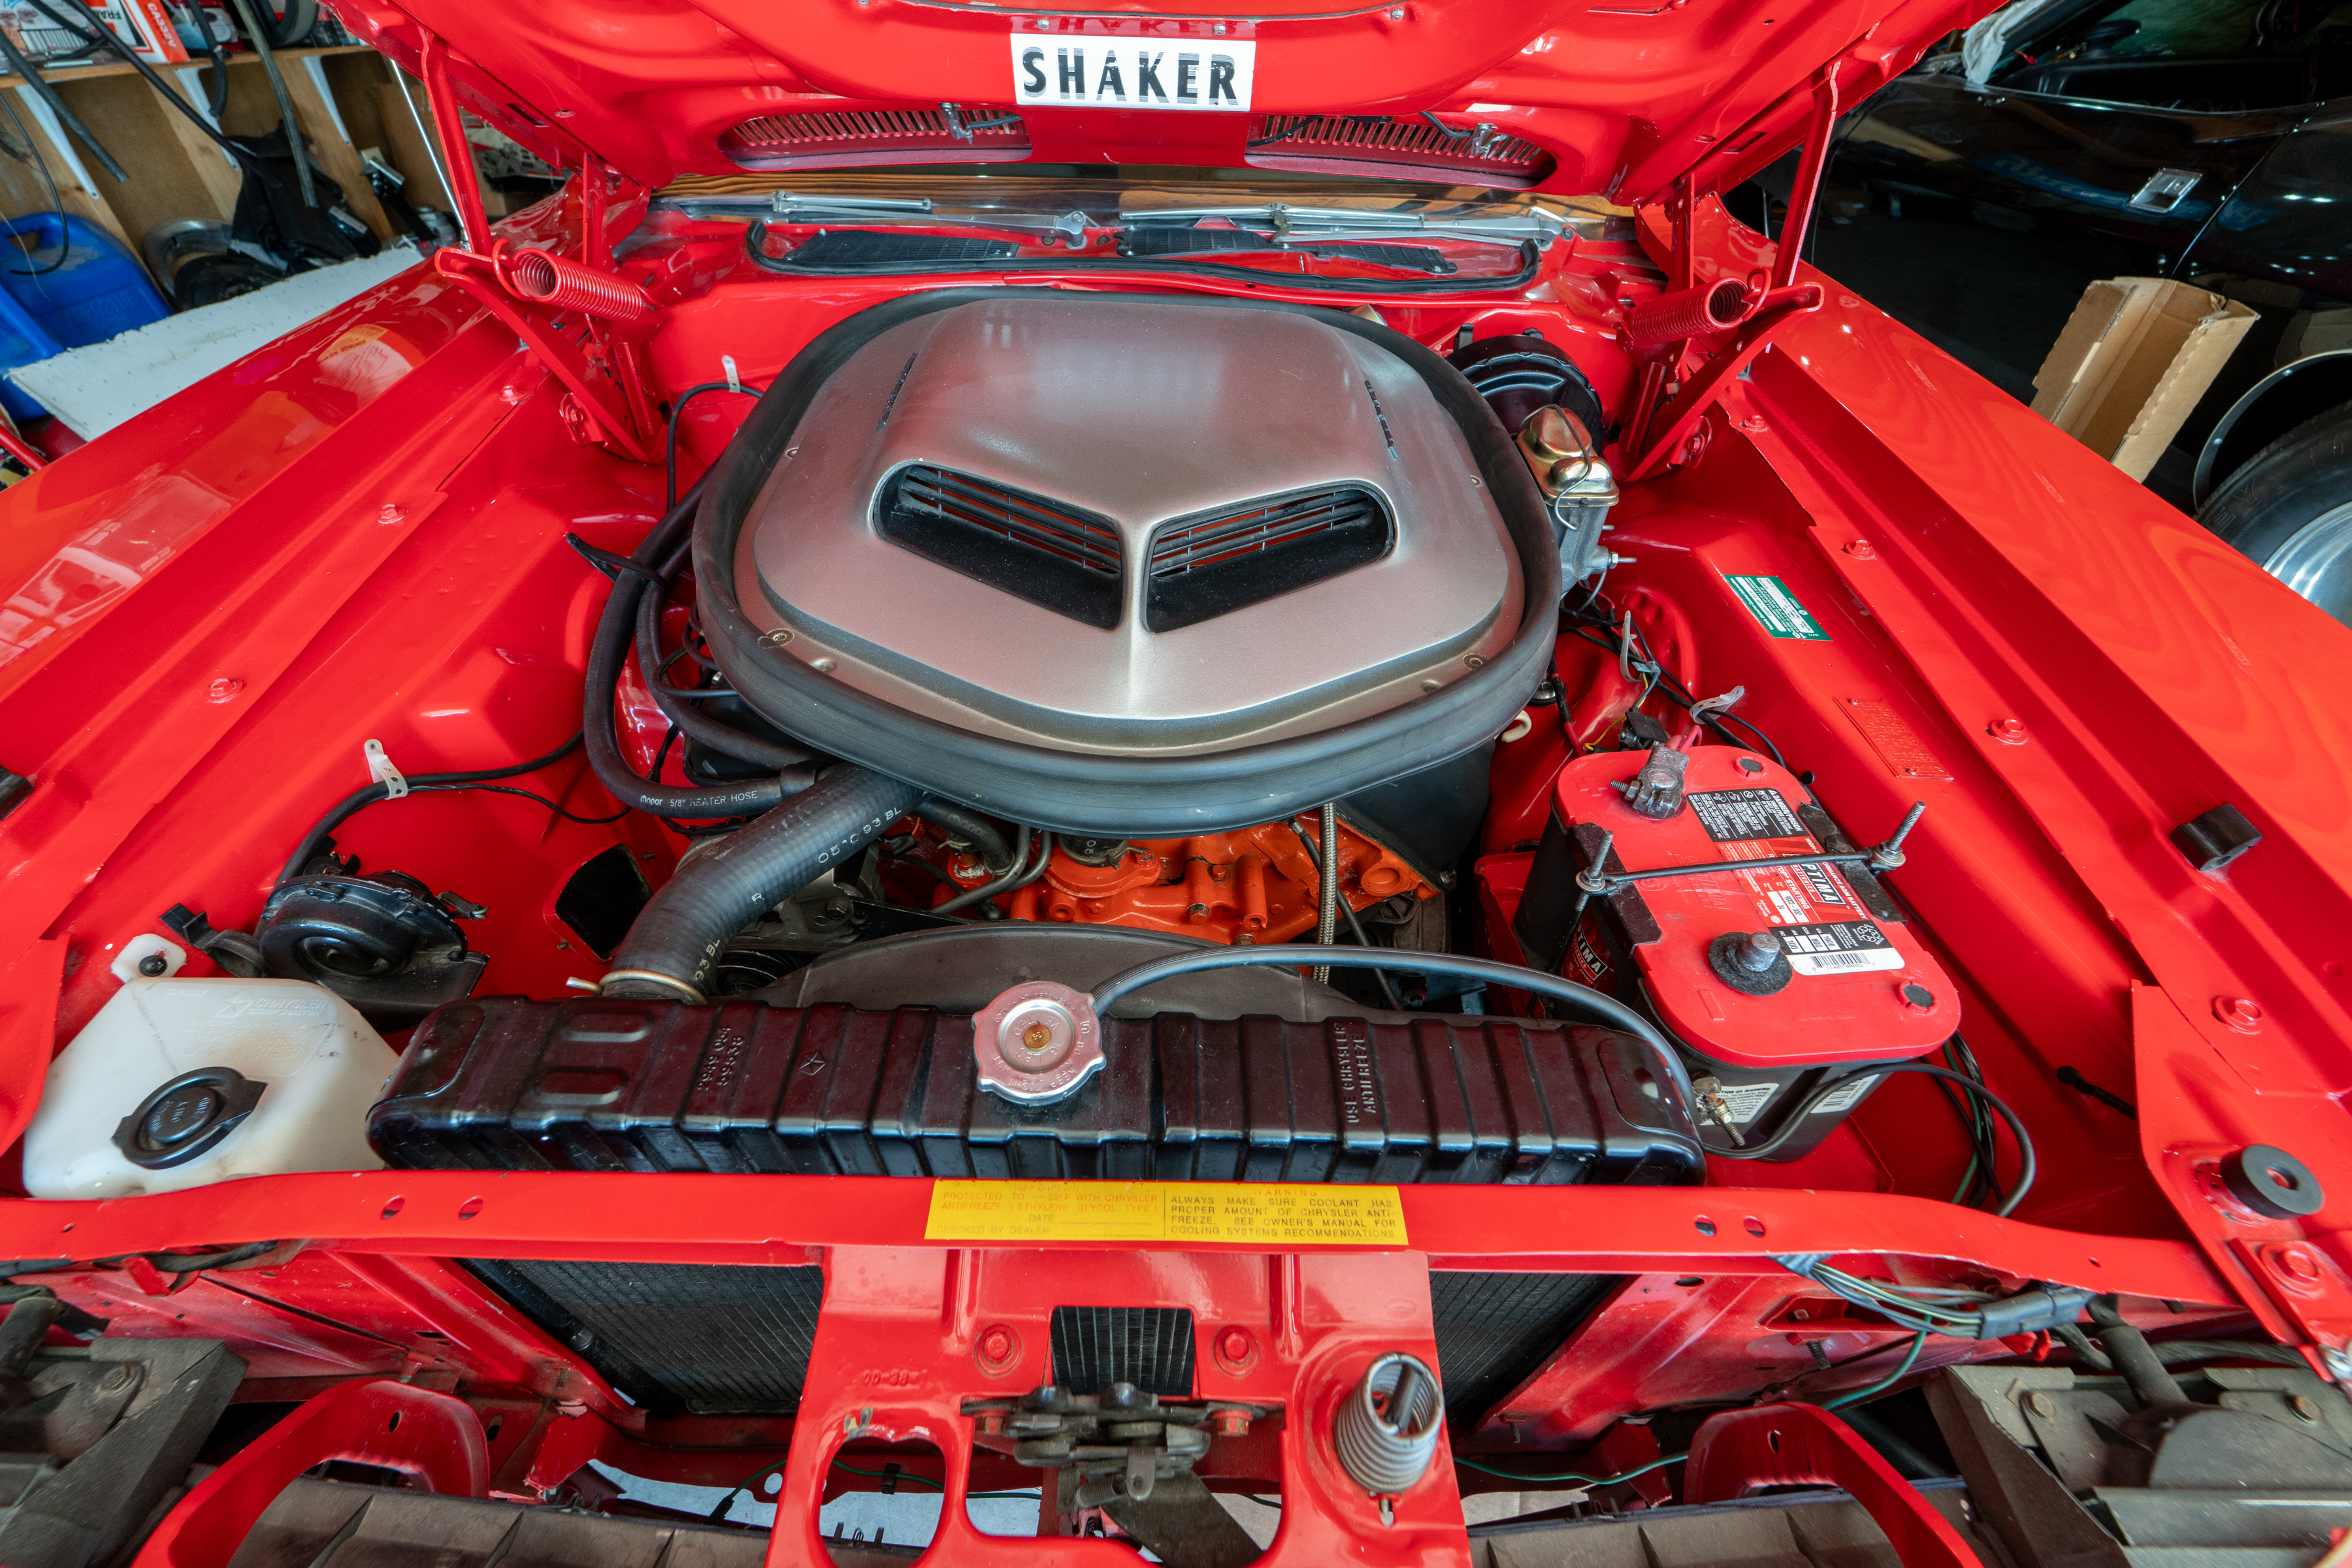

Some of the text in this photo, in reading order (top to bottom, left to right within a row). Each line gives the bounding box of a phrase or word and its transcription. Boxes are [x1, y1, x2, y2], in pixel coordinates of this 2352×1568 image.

[1021, 46, 1239, 106] SHAKER
[1728, 578, 1775, 630] Vehicle Emission Control Information
[640, 794, 664, 806] Mopar
[690, 795, 727, 808] HEATER
[730, 791, 759, 802] HOSE
[885, 807, 902, 821] BL
[1771, 794, 1805, 831] DANGER/POISON
[1791, 864, 1816, 892] BATTERIES
[1800, 863, 1840, 902] PTIMA
[1784, 879, 1810, 909] STARTING
[1758, 899, 1772, 913] Johnson
[1838, 885, 1868, 919] AGM BATTERY
[1755, 902, 1769, 917] Controls
[706, 939, 721, 957] BL
[1577, 924, 1602, 973] PTIMA
[1786, 939, 1799, 949] 100
[1810, 938, 1823, 947] 800
[1822, 936, 1836, 947] 1000
[255, 998, 329, 1010] CHRYSLER
[250, 1007, 323, 1017] CORPORATION
[1013, 1014, 1060, 1036] VENTED
[1016, 1043, 1062, 1064] 16 LBS
[1073, 1041, 1085, 1055] DO
[991, 1055, 1012, 1074] HOT
[1006, 1068, 1077, 1092] KEEP TIGHT
[1334, 1026, 1360, 1124] USE CHRYSLER
[1352, 1034, 1377, 1114] ANTIFREEZE
[943, 1192, 1003, 1201] PROTECTED
[1105, 1194, 1158, 1203] CHRYSLER
[1253, 1188, 1317, 1197] WARNING
[941, 1202, 1002, 1211] ANTIFREEZE
[1077, 1204, 1117, 1213] GLYCOL
[1171, 1196, 1394, 1209] ALWAYS MAKE SURE COOLANT HAS
[1171, 1205, 1215, 1215] PROPER
[1224, 1207, 1269, 1216] AMOUNT
[1300, 1209, 1359, 1217] CHRYSLER
[1028, 1214, 1055, 1223] DATE
[1234, 1217, 1255, 1226] SEE
[1264, 1218, 1314, 1227] OWNER'S
[1322, 1219, 1367, 1228] MANUAL
[936, 1225, 985, 1235] CHECKED
[990, 1226, 1004, 1235] BY
[1171, 1226, 1220, 1236] COOLING
[1227, 1227, 1279, 1237] SYSTEMS
